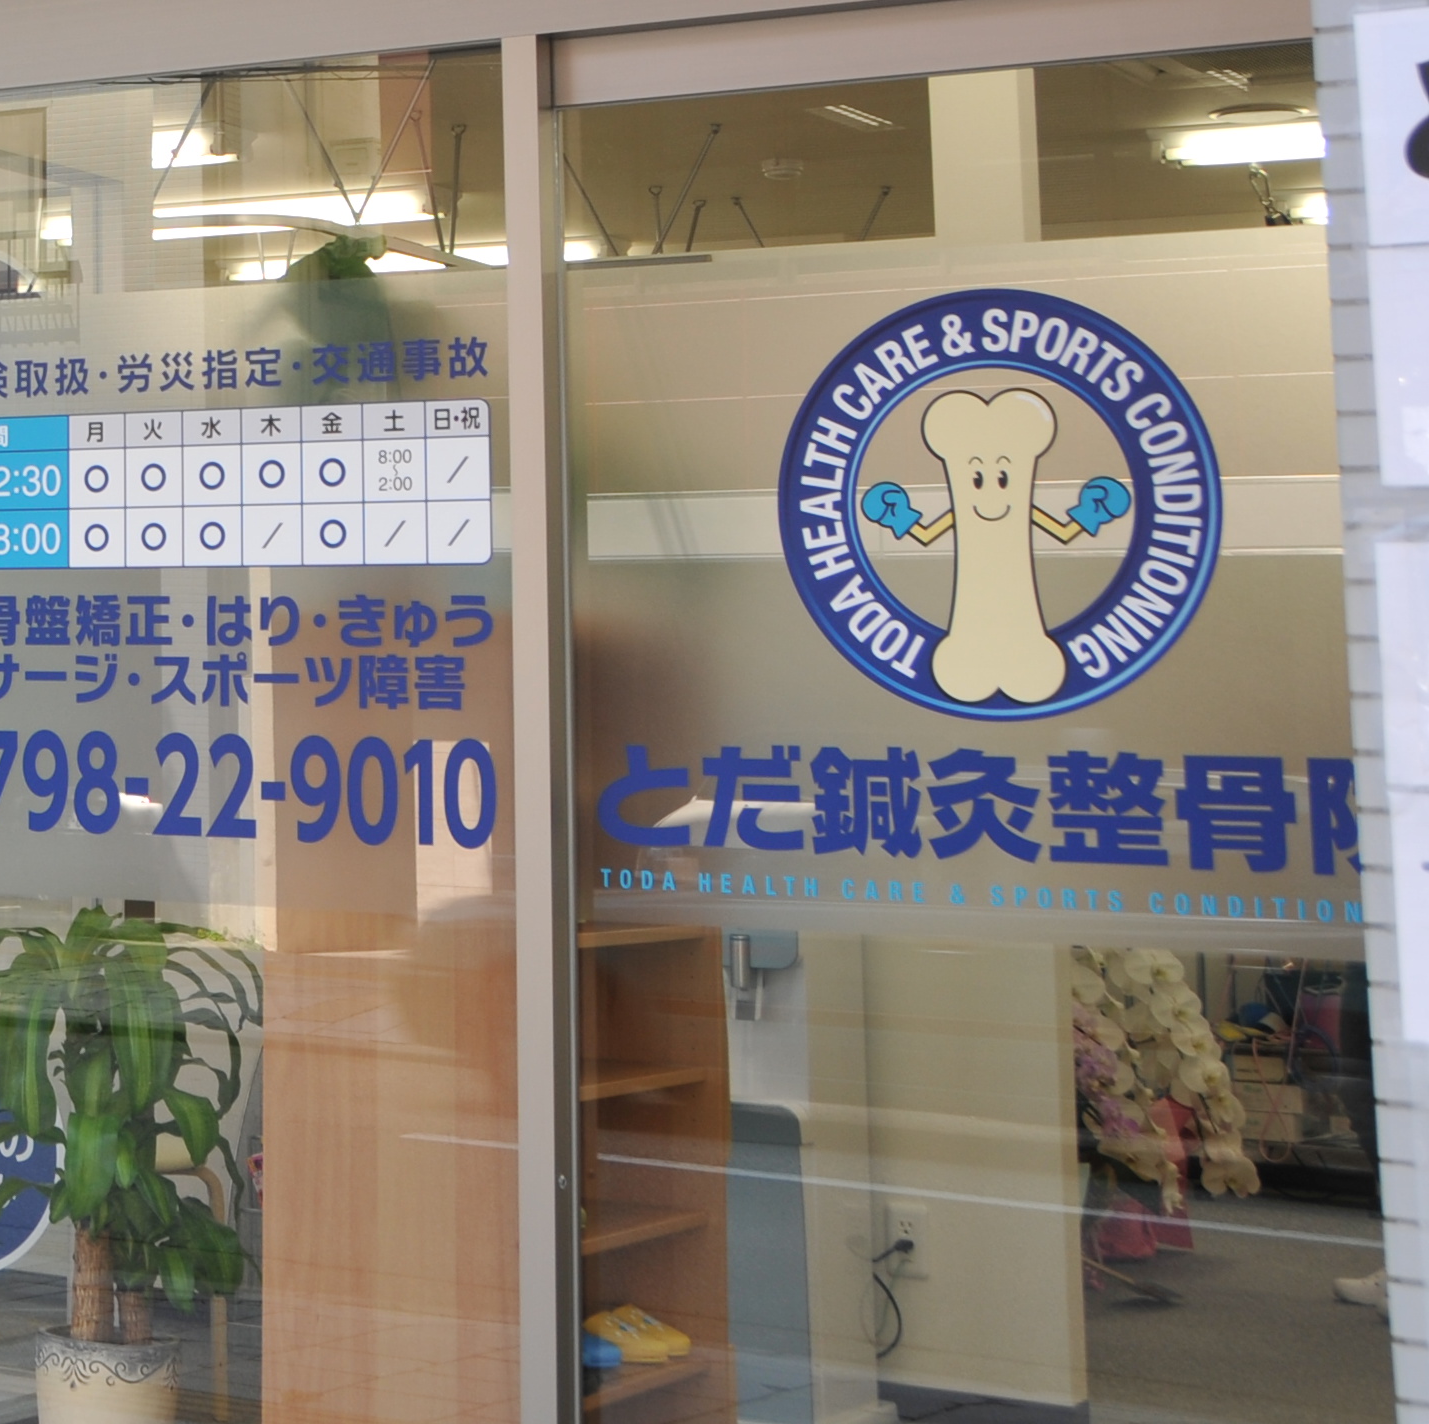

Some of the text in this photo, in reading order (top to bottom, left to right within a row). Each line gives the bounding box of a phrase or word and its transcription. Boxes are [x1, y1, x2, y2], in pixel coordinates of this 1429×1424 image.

[87, 421, 106, 444] 月
[143, 419, 164, 441] 火
[201, 417, 222, 439] 水
[260, 414, 282, 437] 木
[320, 411, 343, 434] 金
[384, 410, 406, 432] 土
[433, 406, 481, 431] 日・祝
[378, 448, 413, 465] 8:00
[378, 475, 413, 492] 2:00
[800, 308, 1202, 680] TODA HEALTH CARE & SPORTS CONDITIONING
[600, 868, 678, 892] TODA
[698, 873, 819, 898] HEALTH
[841, 880, 926, 904] CARE
[950, 883, 966, 905] &
[991, 885, 1124, 913] SPORTS
